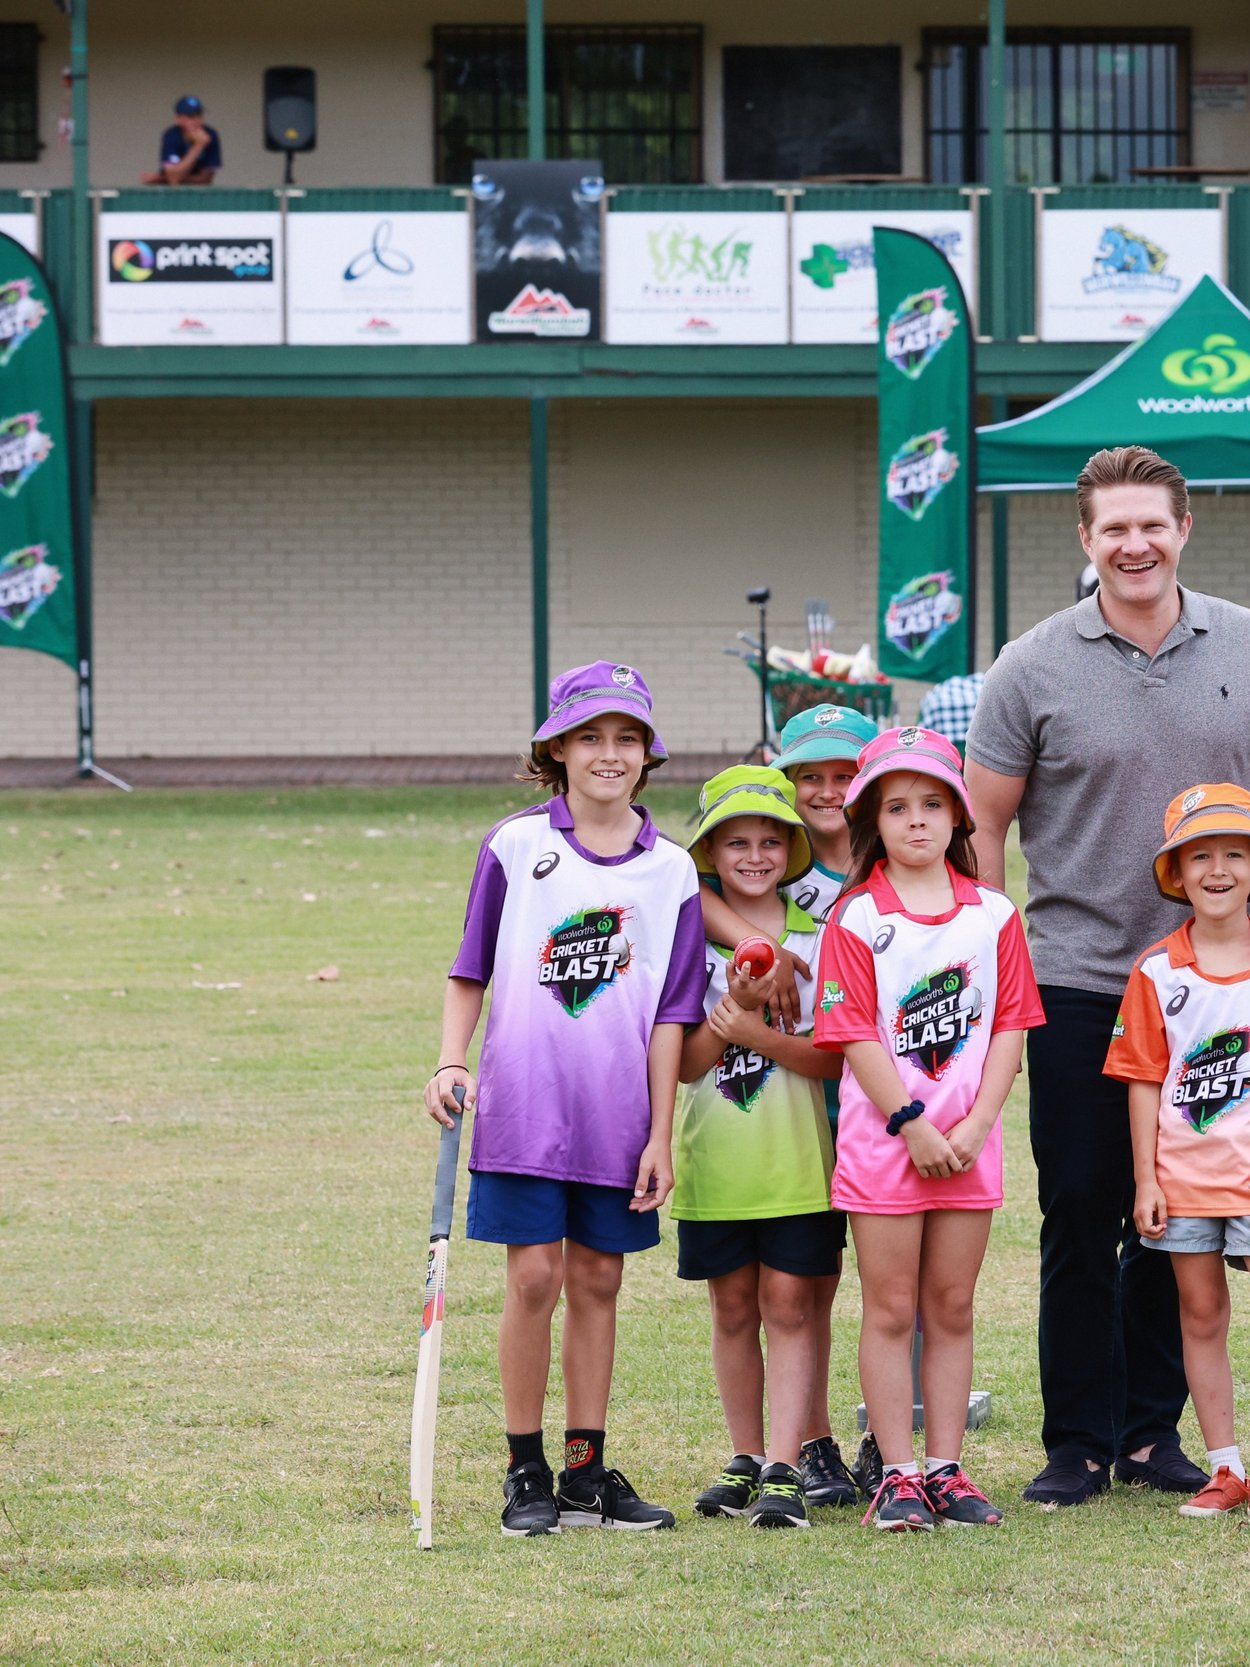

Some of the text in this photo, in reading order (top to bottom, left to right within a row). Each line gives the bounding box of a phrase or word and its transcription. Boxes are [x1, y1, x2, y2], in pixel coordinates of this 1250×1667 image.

[156, 241, 270, 271] print spot
[557, 925, 597, 942] woolworths
[549, 936, 609, 960] CRICKET
[538, 953, 621, 984] BLAST
[902, 994, 958, 1028] CRICKET
[906, 987, 944, 1011] woolworths
[895, 1007, 974, 1055] BLAST
[1182, 1056, 1237, 1083] CRICKET
